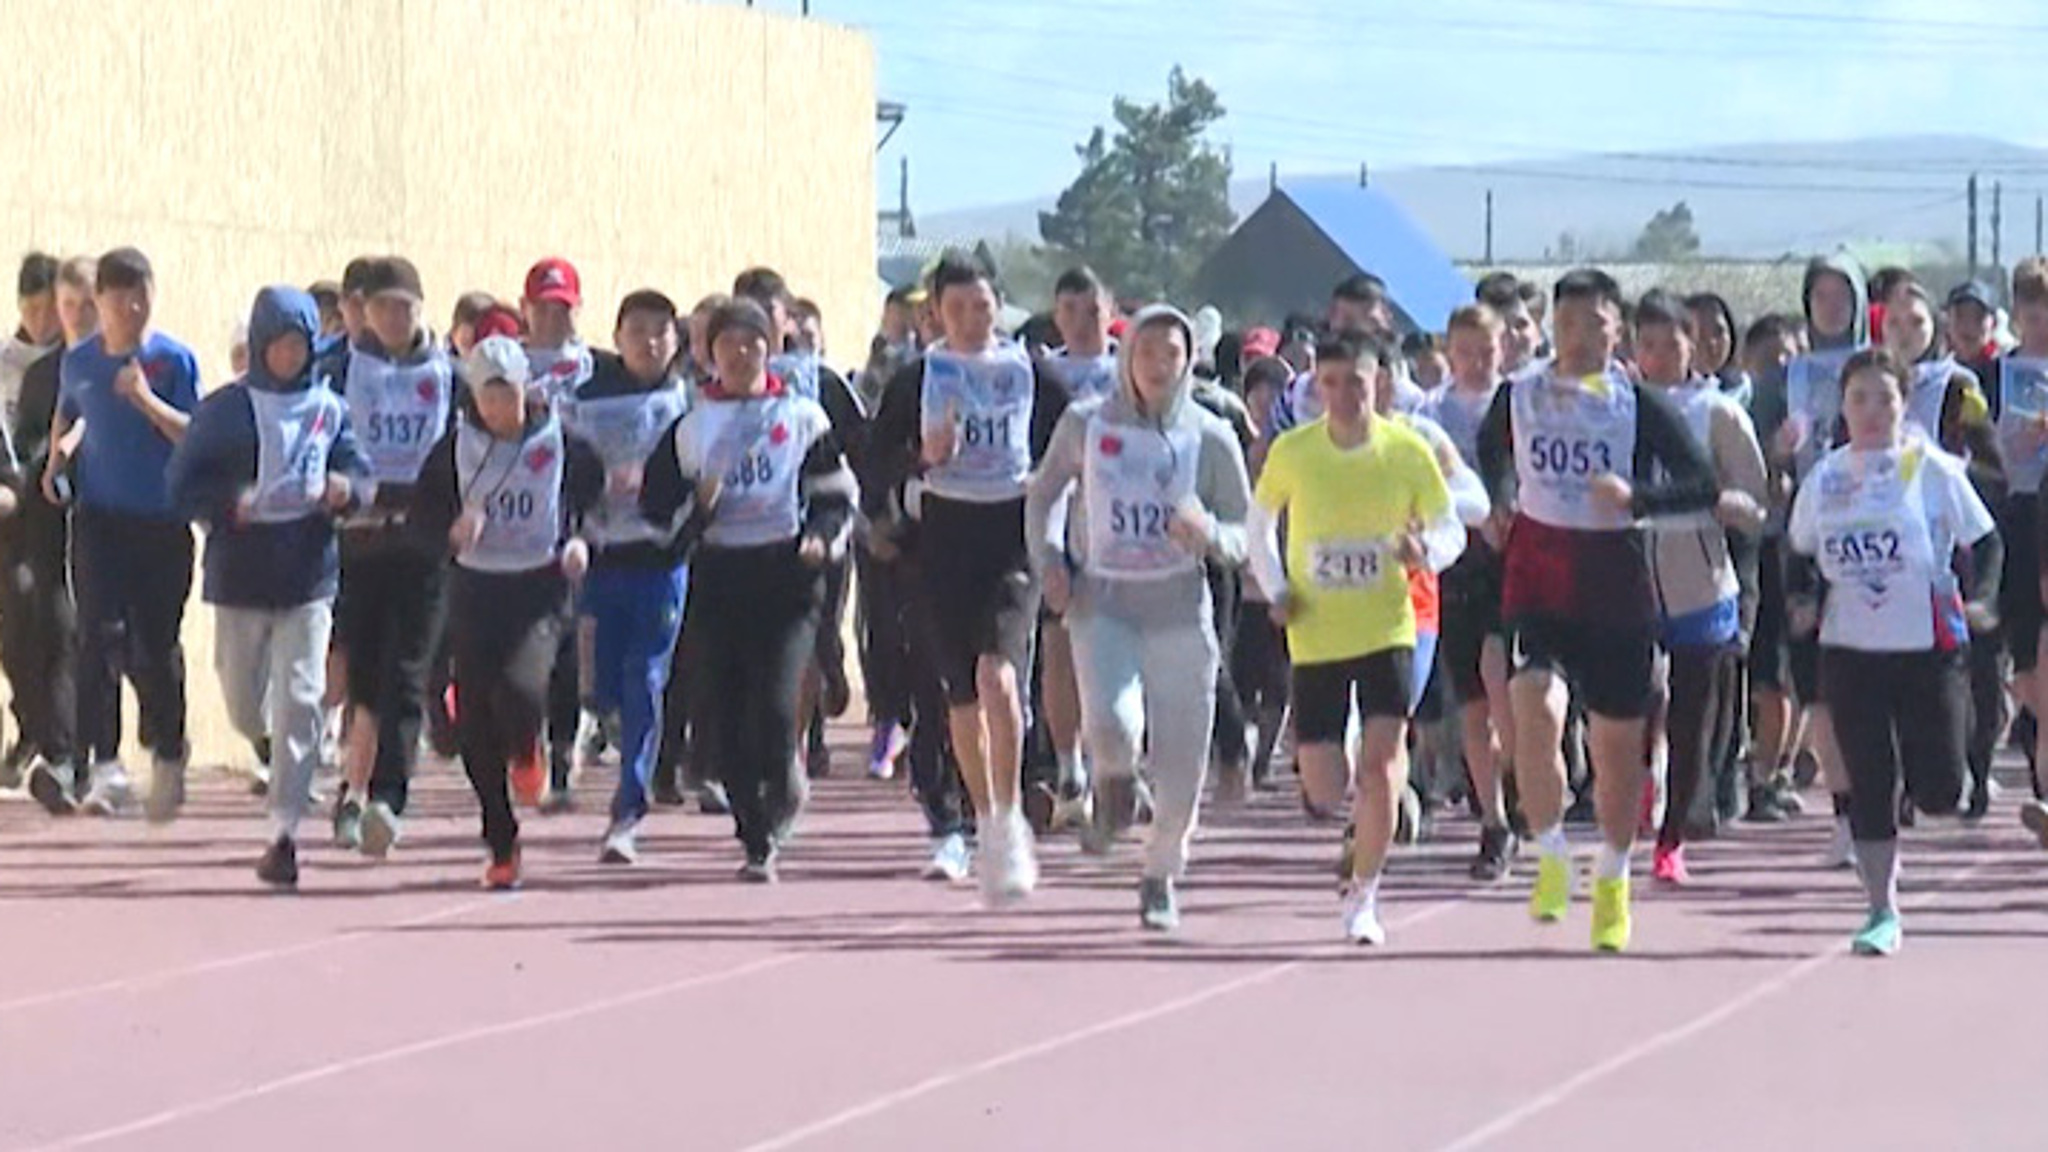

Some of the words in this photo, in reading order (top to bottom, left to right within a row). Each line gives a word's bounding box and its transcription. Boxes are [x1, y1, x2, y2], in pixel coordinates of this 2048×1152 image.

[367, 411, 427, 443] 5137
[953, 411, 1010, 446] 611
[1531, 435, 1611, 475] 5053
[1824, 529, 1903, 563] 5052
